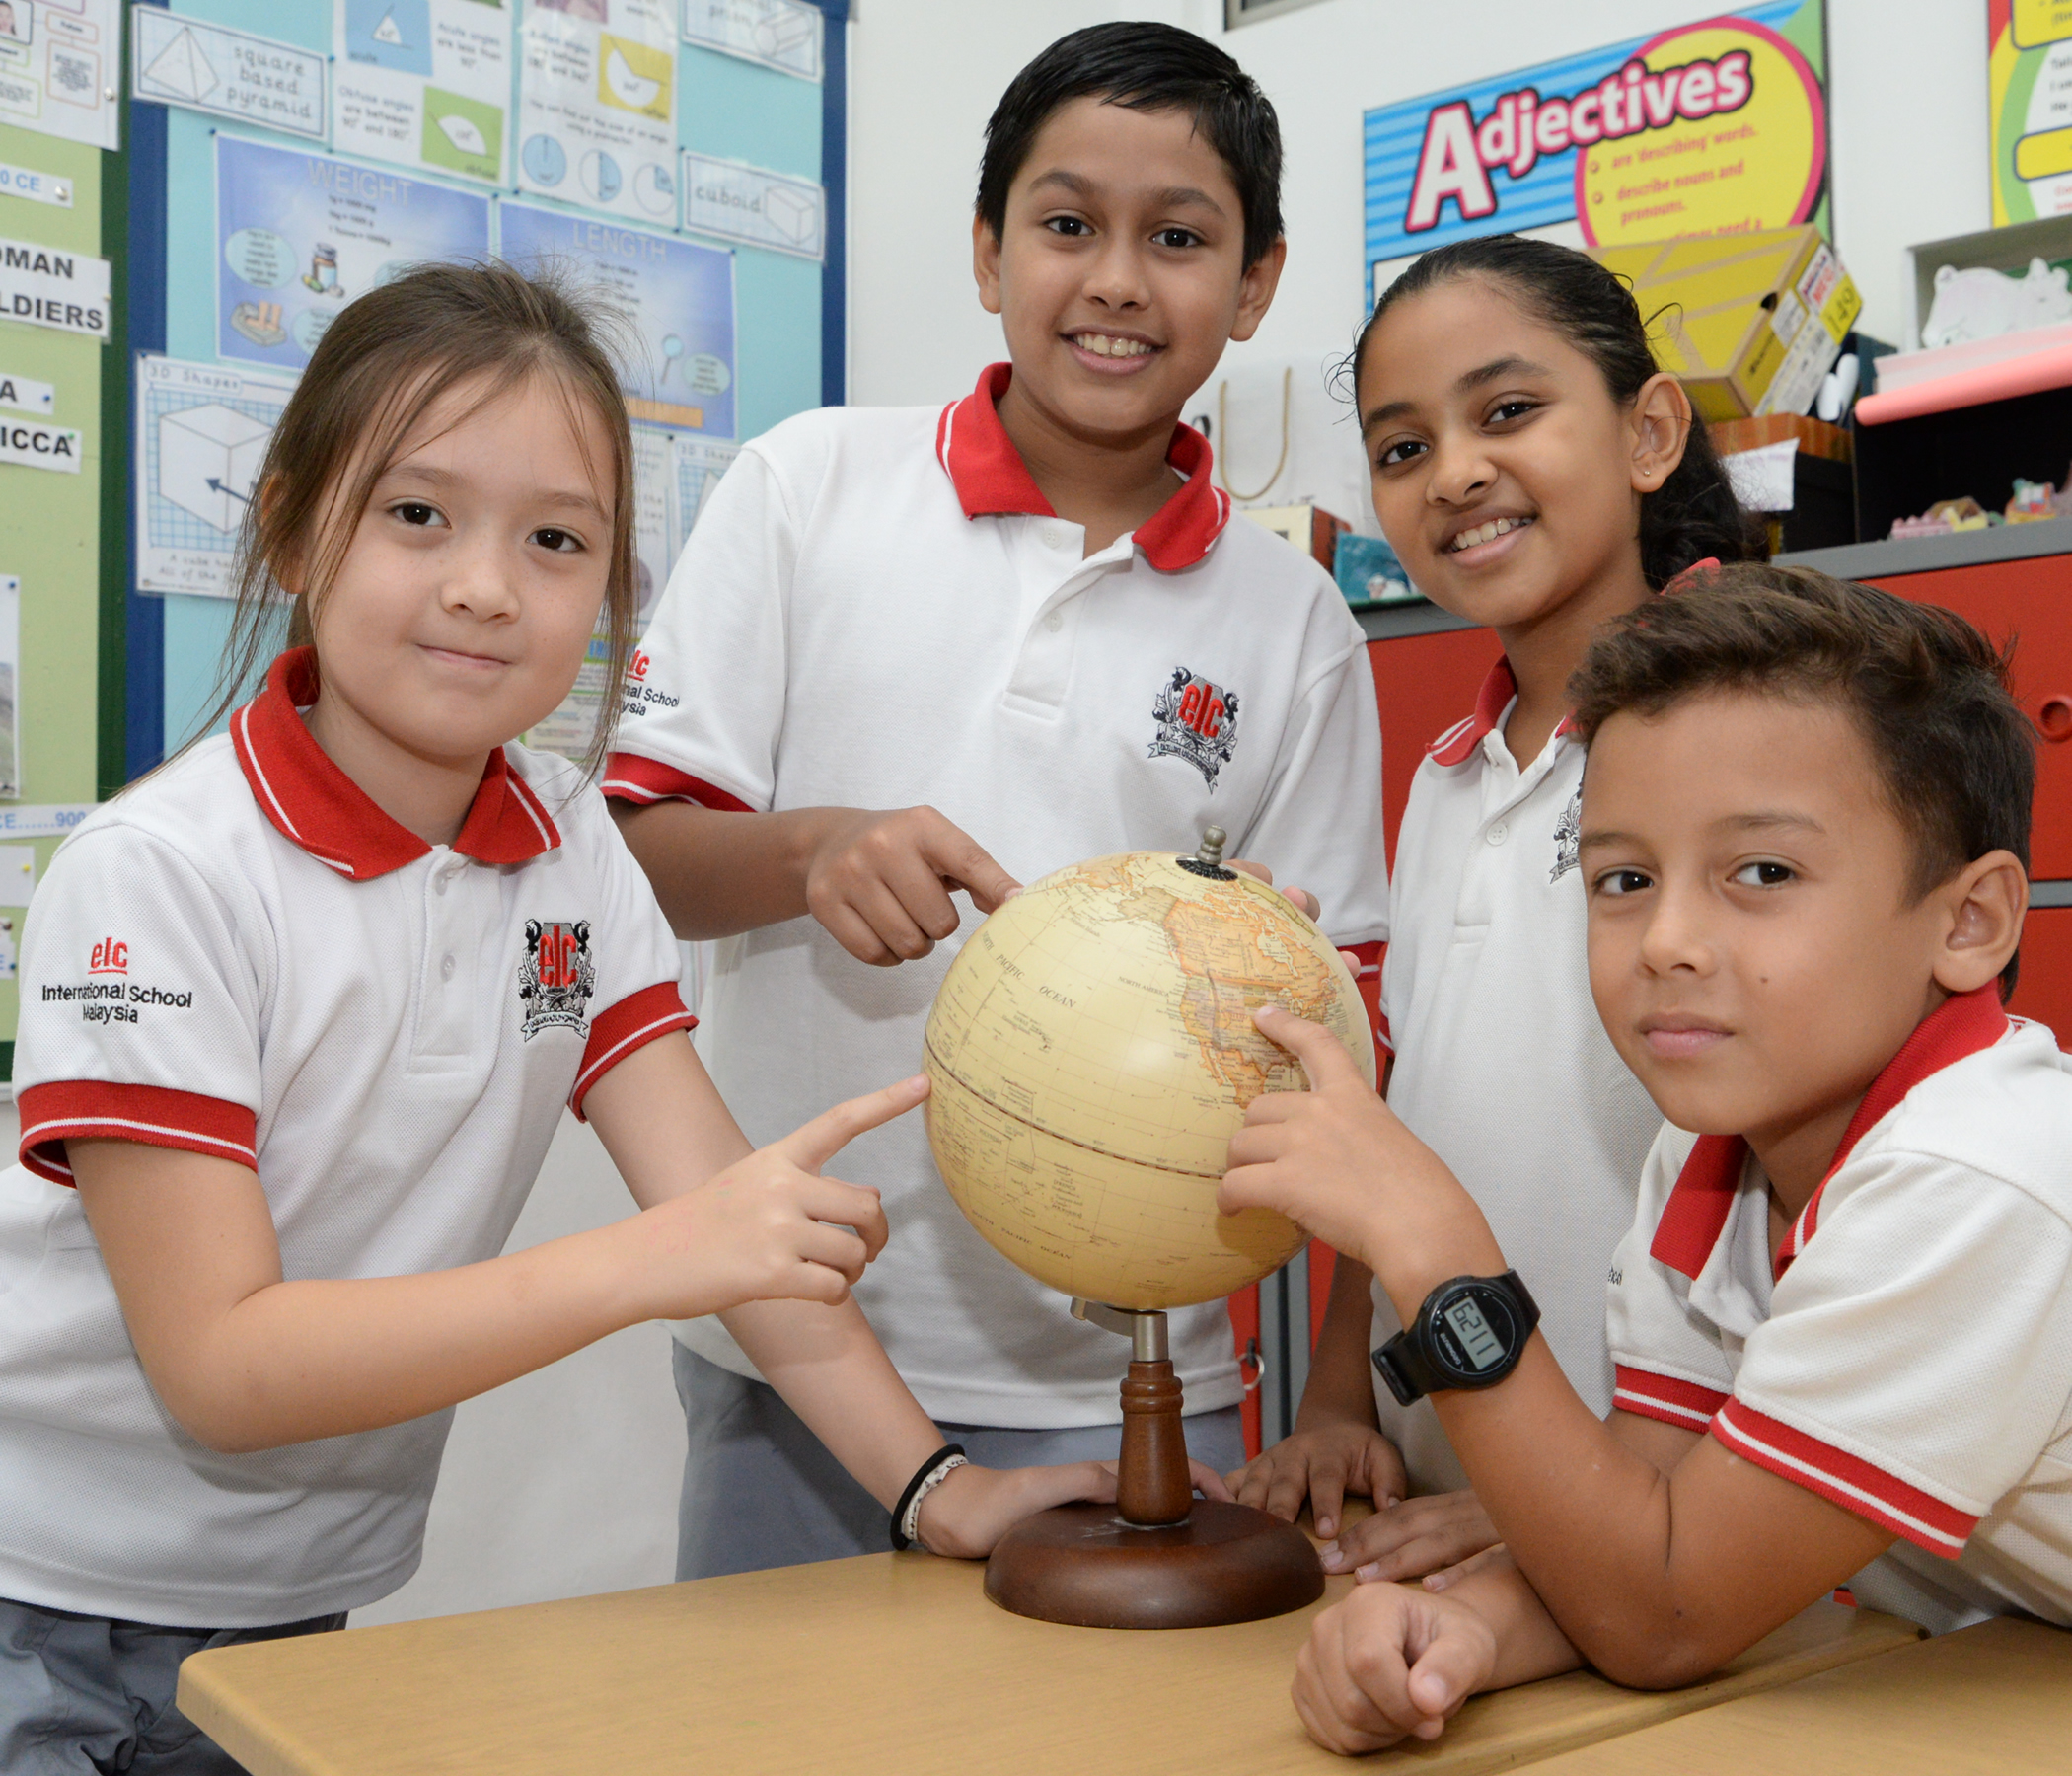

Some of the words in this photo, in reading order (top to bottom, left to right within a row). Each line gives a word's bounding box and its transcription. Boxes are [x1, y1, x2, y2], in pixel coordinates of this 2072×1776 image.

[234, 46, 305, 77] square
[239, 64, 299, 96] based
[226, 87, 312, 119] pyramid
[1405, 50, 1751, 232] Adjectives
[1611, 153, 1633, 170] are
[1713, 123, 1759, 145] words.
[16, 174, 40, 192] CE
[307, 158, 413, 206] WEIGHT
[1616, 178, 1670, 201] describe
[1674, 170, 1715, 187] nouns
[1719, 159, 1744, 179] and
[696, 185, 762, 214] cuboid
[1620, 199, 1687, 227] pronouns.
[572, 222, 667, 262] LENGTH
[0, 247, 73, 279] MAN
[1, 426, 72, 456] ICCA
[622, 702, 647, 716] ysia
[1178, 683, 1225, 738] elc
[91, 937, 128, 968] elc
[539, 925, 578, 988] elc
[42, 982, 125, 1001] International
[129, 985, 192, 1008] School
[996, 954, 1025, 981] PACIFIC
[1039, 985, 1076, 1007] OCEAN
[1118, 975, 1141, 989] NORTH
[1142, 984, 1170, 998] AMERICA
[83, 1003, 138, 1025] Malaysia
